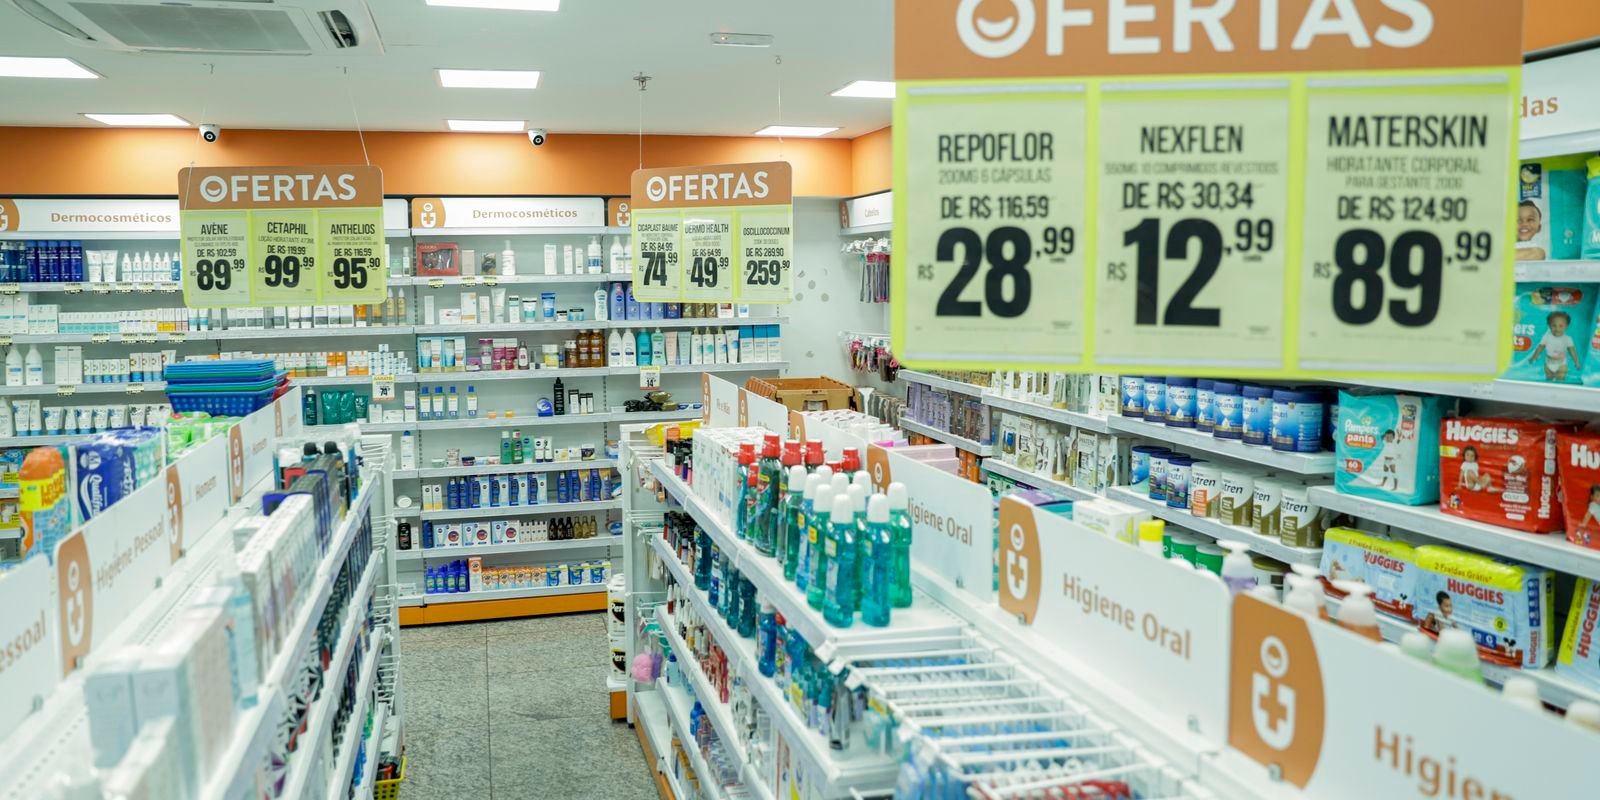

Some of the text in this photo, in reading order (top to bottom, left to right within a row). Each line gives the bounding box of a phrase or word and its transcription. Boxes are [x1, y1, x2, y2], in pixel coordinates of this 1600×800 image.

[1141, 125, 1243, 153] NEXFLEN
[1328, 115, 1487, 148] MATERSKIN
[938, 132, 1054, 163] REPOFLOR
[199, 173, 357, 202] OFERTAS
[646, 171, 769, 202] OFERTAS
[1123, 181, 1254, 211] DE R$ 30,34
[51, 212, 172, 223] Dermocosméticos
[472, 209, 578, 219] Dermocosméticos
[941, 196, 1049, 221] DE R$ 116,59
[1338, 196, 1468, 222] DE R$ 124,90
[267, 222, 308, 235] CETAPHIL
[330, 224, 375, 234] ANTHELIOS
[706, 223, 729, 233] HEALTH
[1345, 419, 1378, 435] Pampers
[1347, 434, 1374, 444] pants
[1446, 420, 1519, 445] HUGGIES
[946, 517, 972, 546] Oral
[1447, 578, 1505, 605] HUGGIES
[1063, 572, 1191, 660] Higiene Oral
